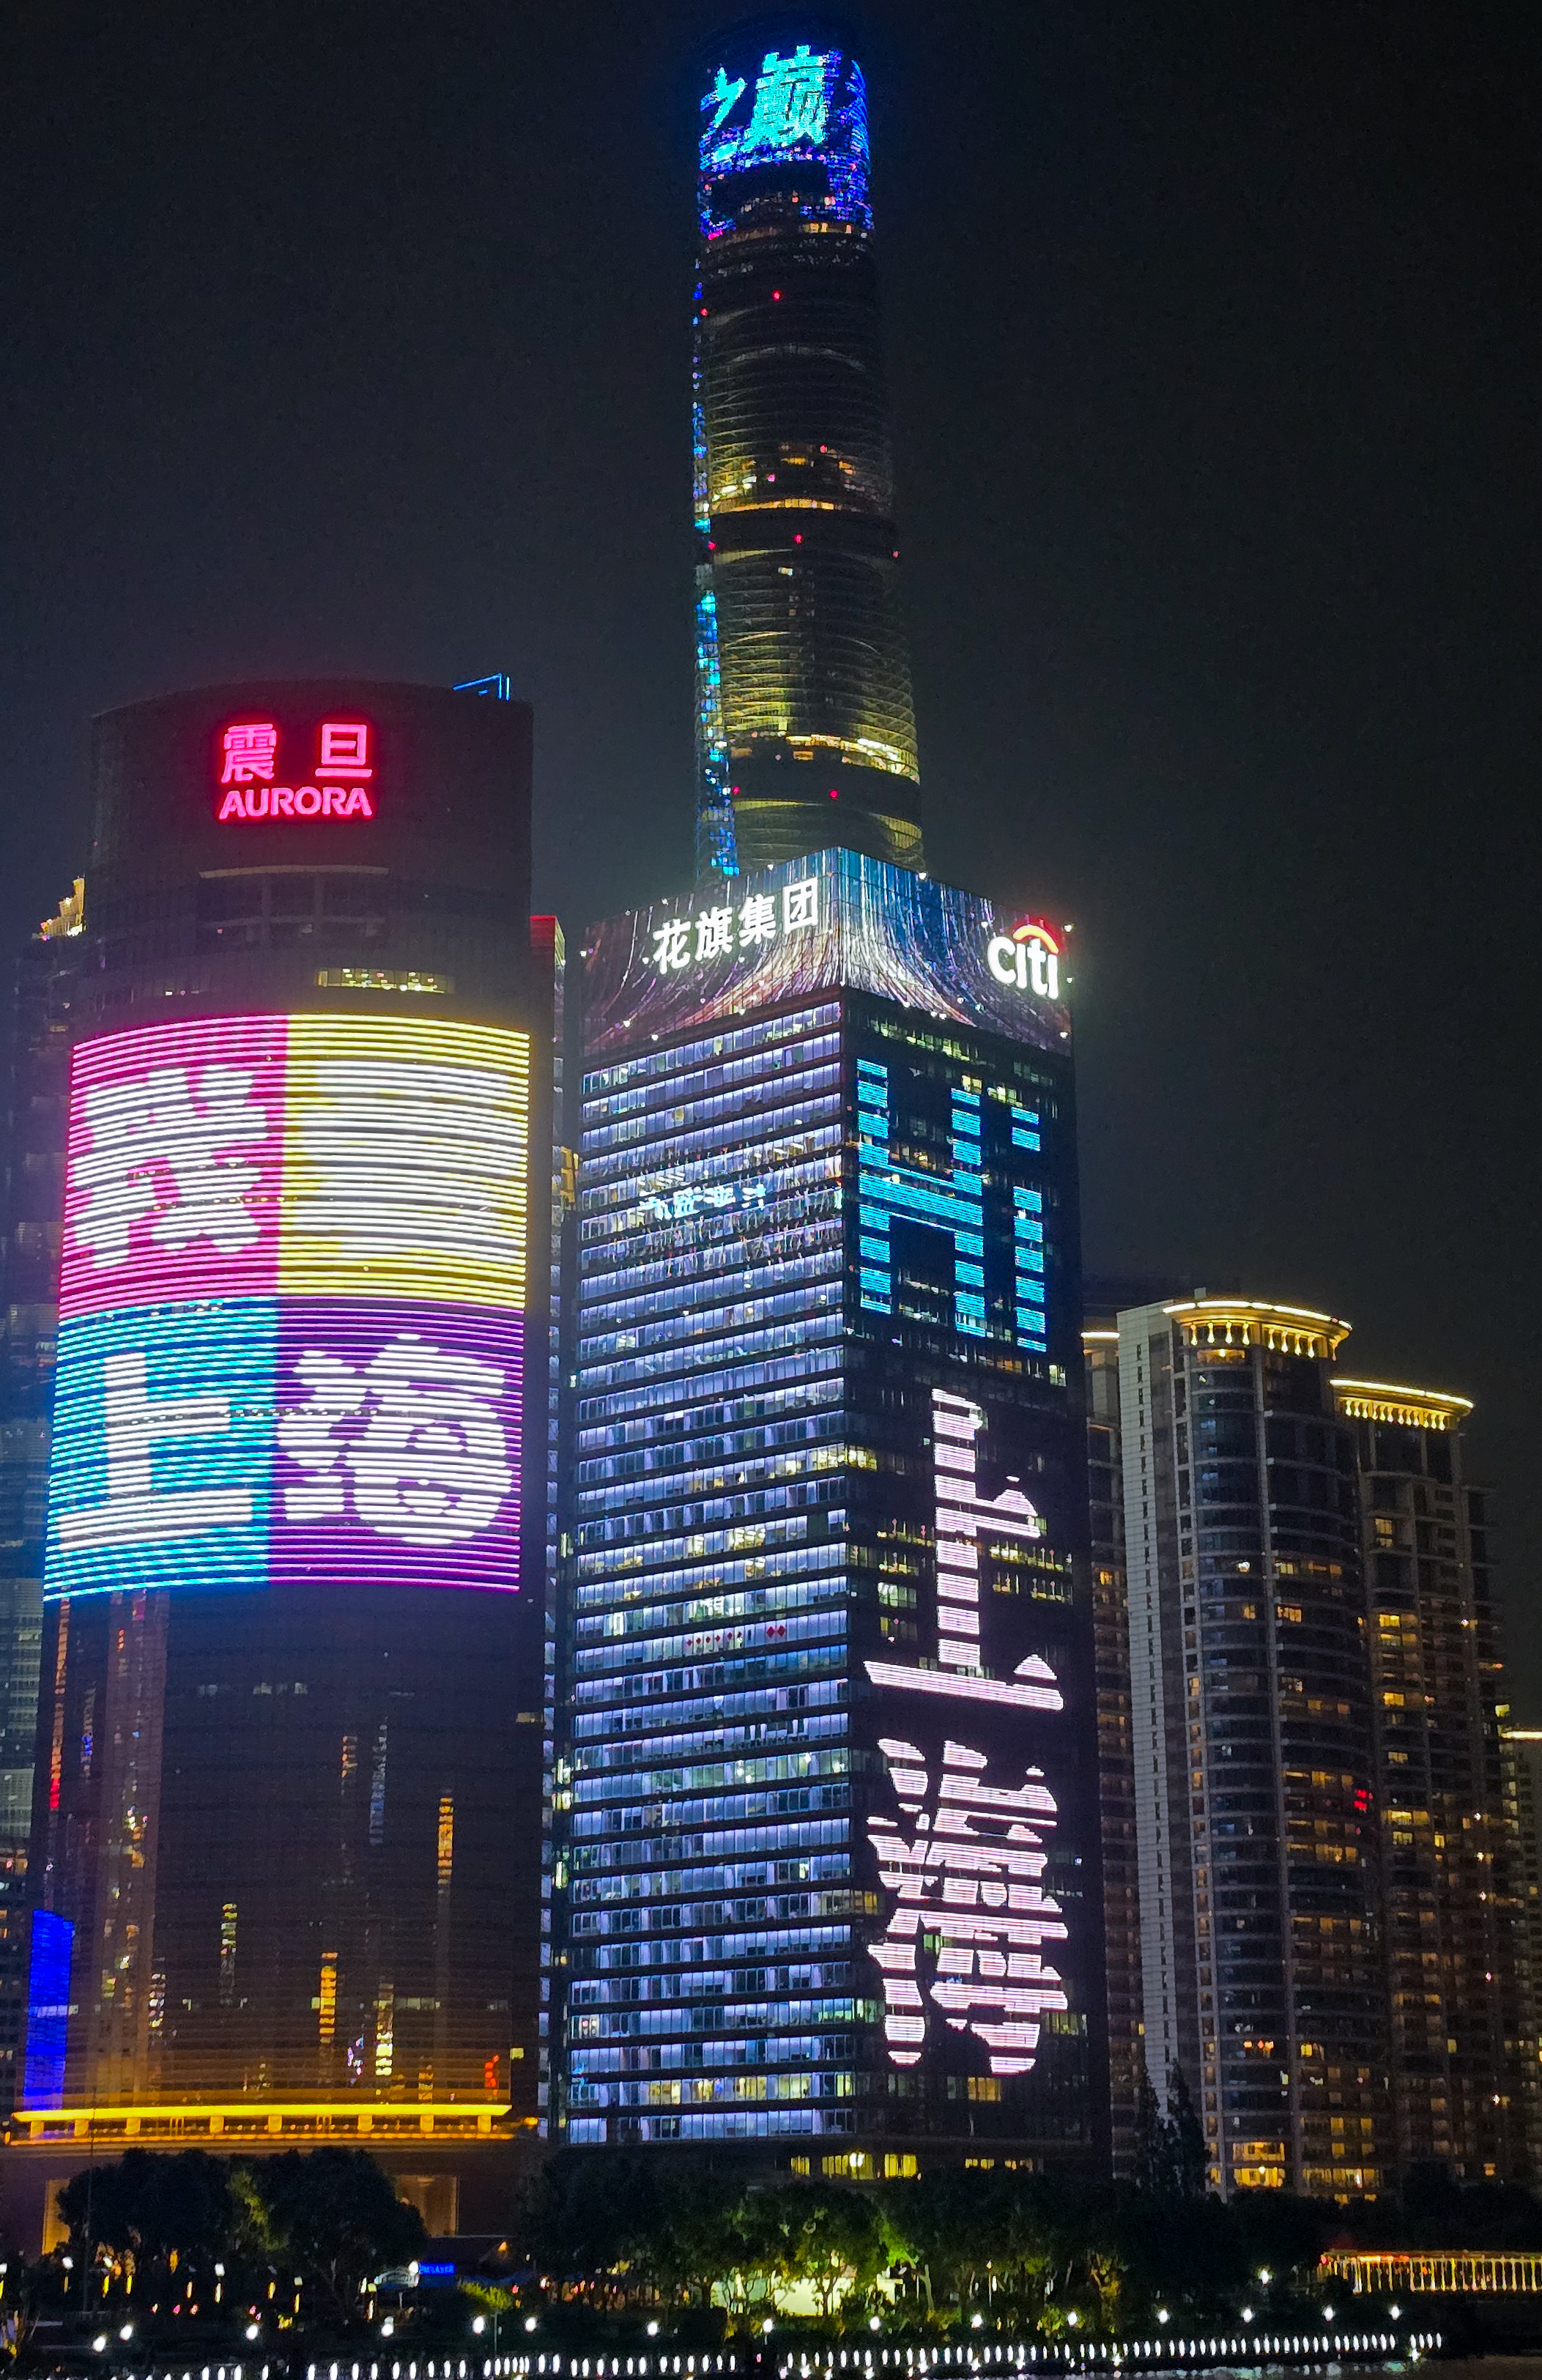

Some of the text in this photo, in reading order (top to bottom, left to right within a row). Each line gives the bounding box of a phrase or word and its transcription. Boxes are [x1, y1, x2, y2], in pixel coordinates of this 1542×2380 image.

[221, 724, 372, 783] 震旦
[220, 787, 372, 819] AURORA
[653, 877, 818, 974] 花旗集团
[987, 936, 1059, 1000] citi
[857, 1059, 1046, 1353] Hi
[56, 1333, 513, 1546] 上海
[864, 1388, 1069, 2075] 上海
